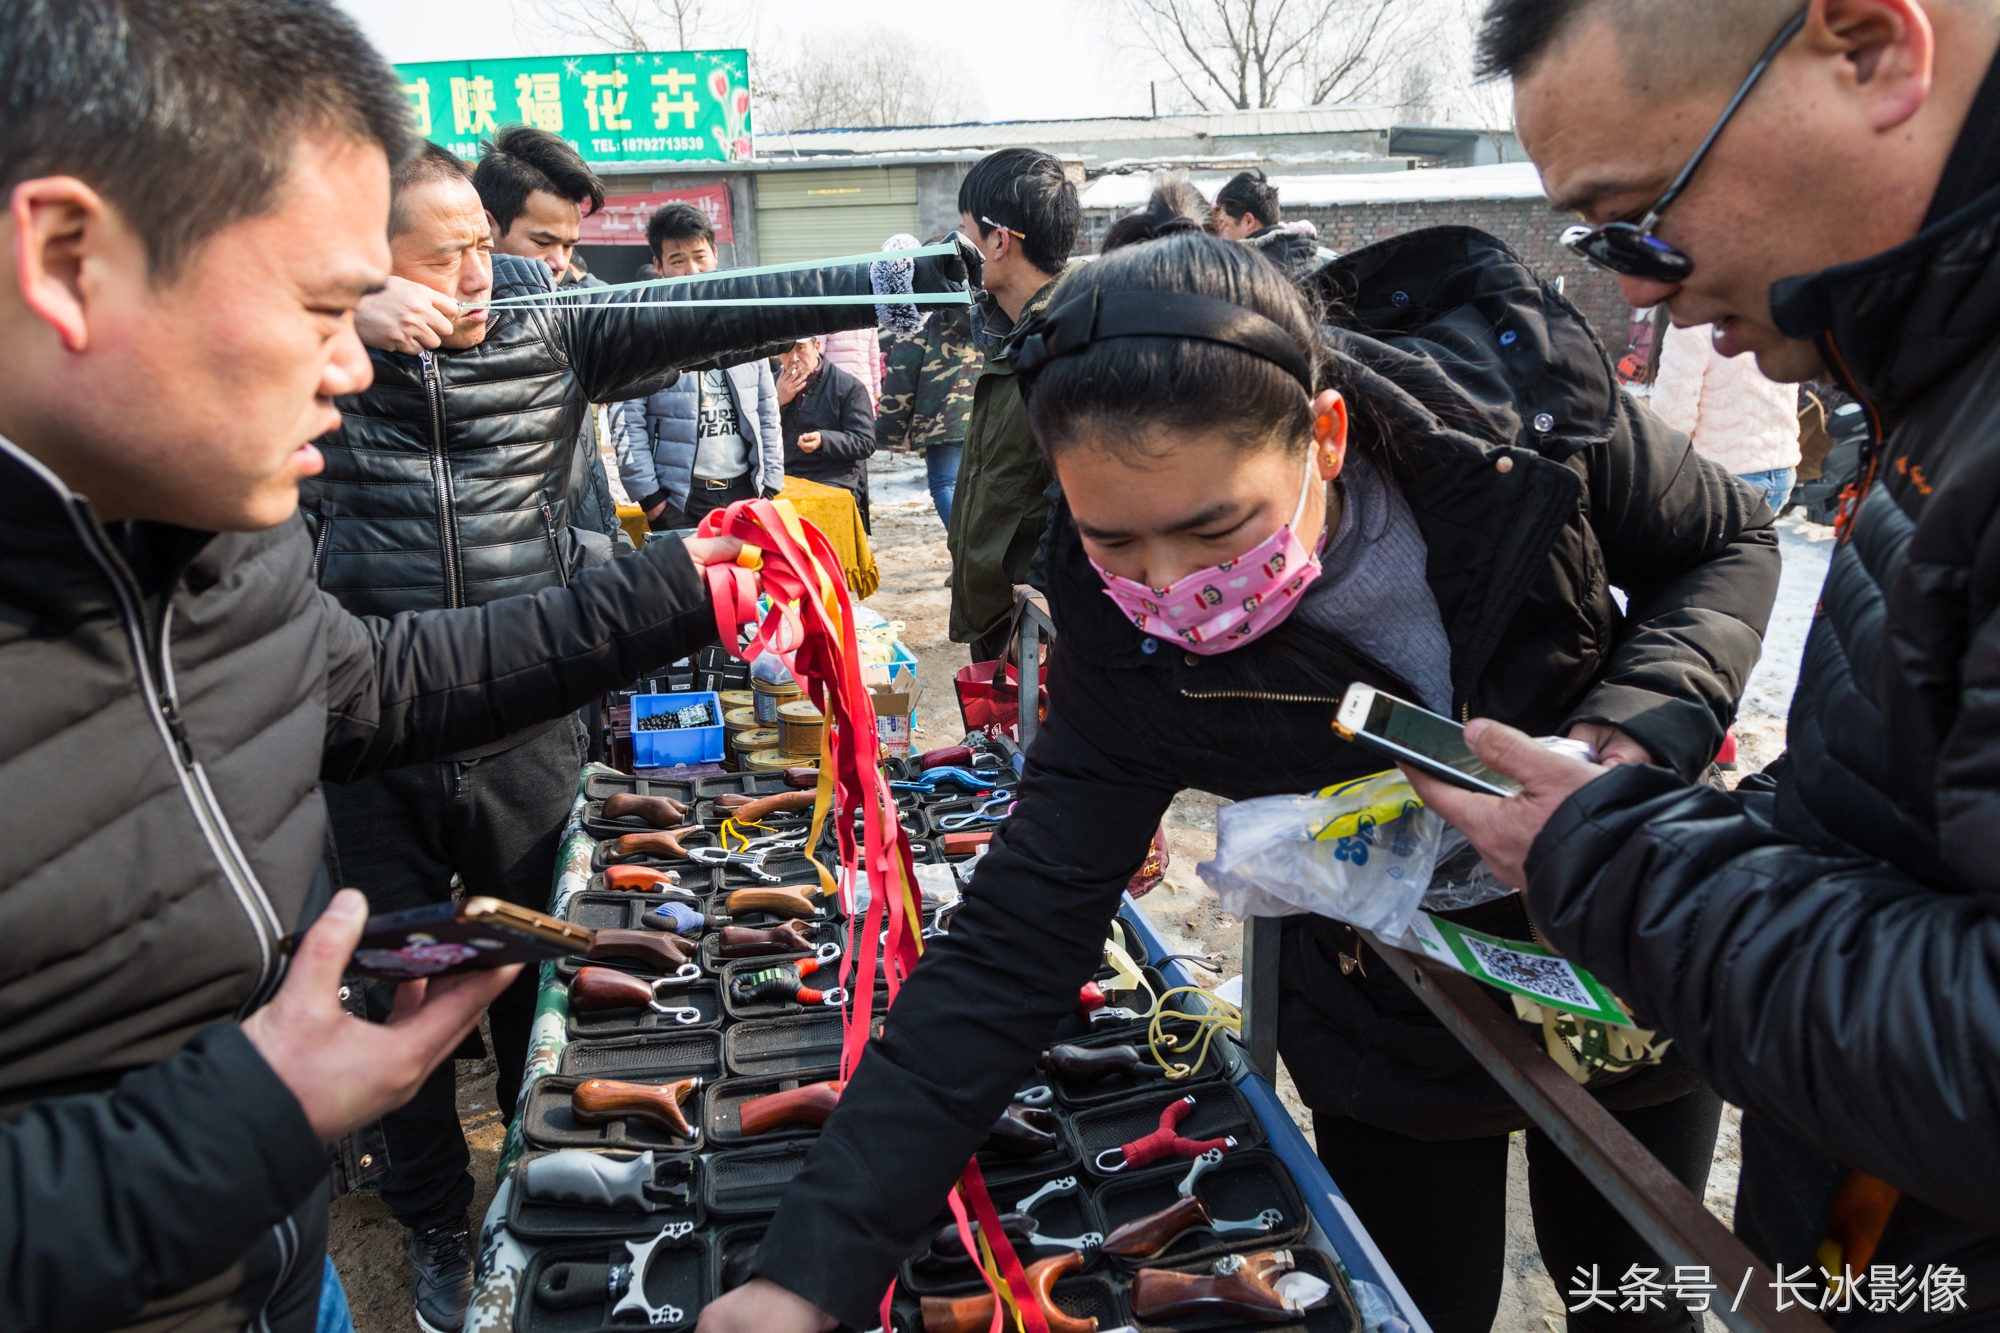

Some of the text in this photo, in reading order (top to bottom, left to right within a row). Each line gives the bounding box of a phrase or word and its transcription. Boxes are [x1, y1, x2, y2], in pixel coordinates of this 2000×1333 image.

[591, 137, 704, 152] TEL:18792713539
[601, 197, 722, 232] 正在业
